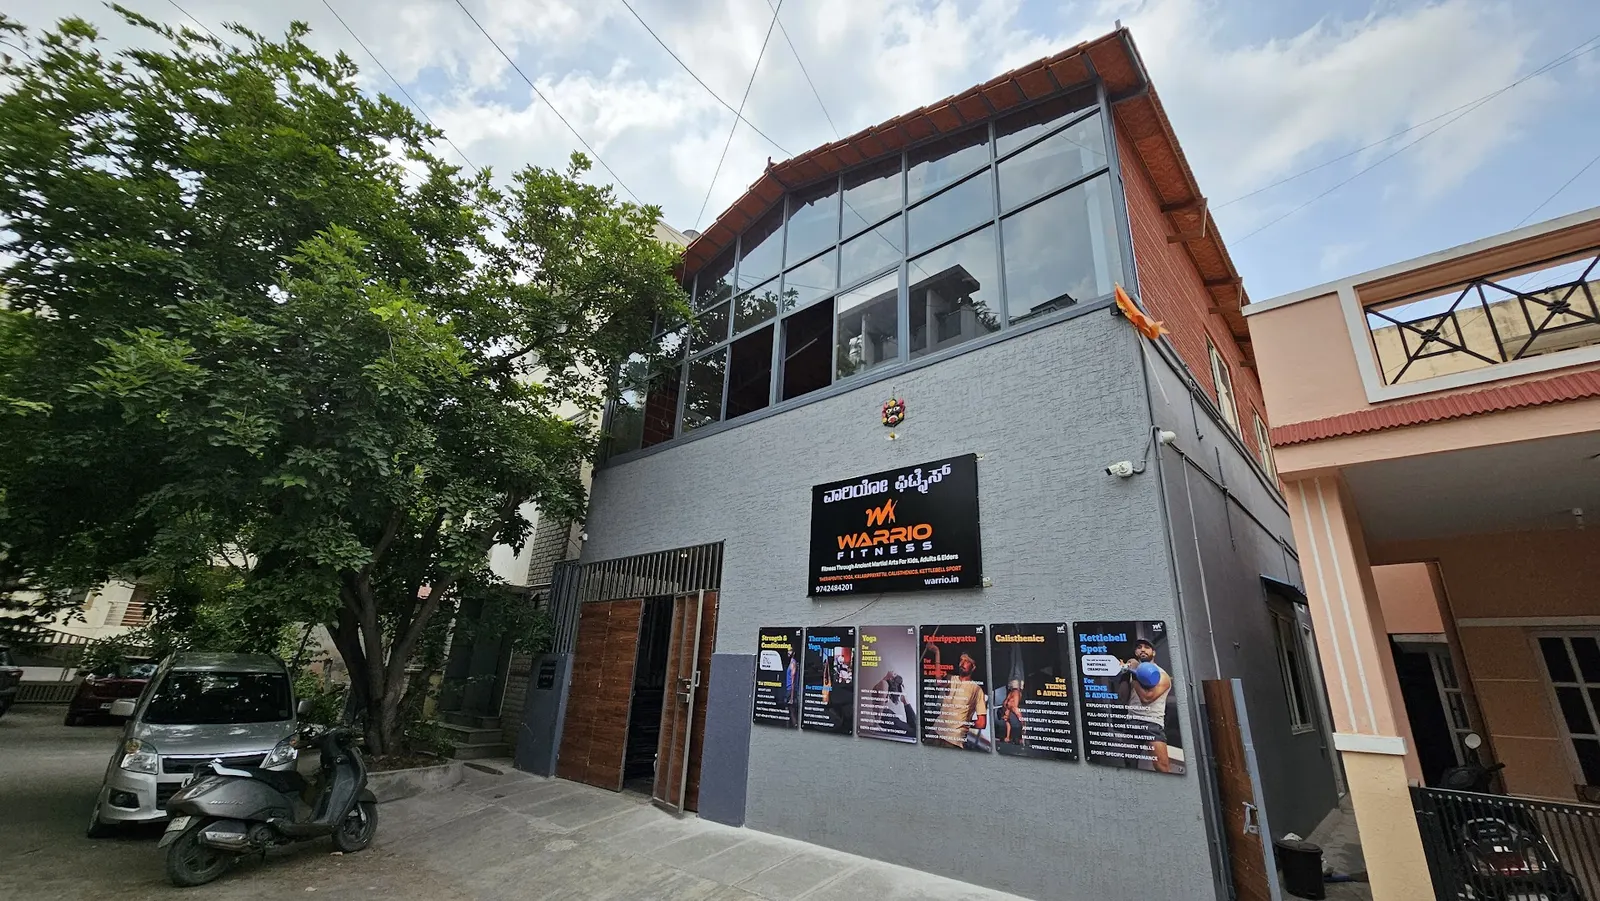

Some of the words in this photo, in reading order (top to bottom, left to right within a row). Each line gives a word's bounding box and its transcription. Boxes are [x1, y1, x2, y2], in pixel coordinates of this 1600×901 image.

[837, 524, 932, 550] WARRIO
[837, 540, 932, 560] FITNESS
[924, 575, 959, 585] warrio.in
[816, 584, 853, 593] 9742484201
[862, 635, 876, 643] Yoga
[924, 635, 976, 644] Kalarippayattu
[995, 634, 1045, 642] Calisthenics
[1079, 634, 1127, 642] Kettlebell
[1081, 645, 1107, 654] Sport
